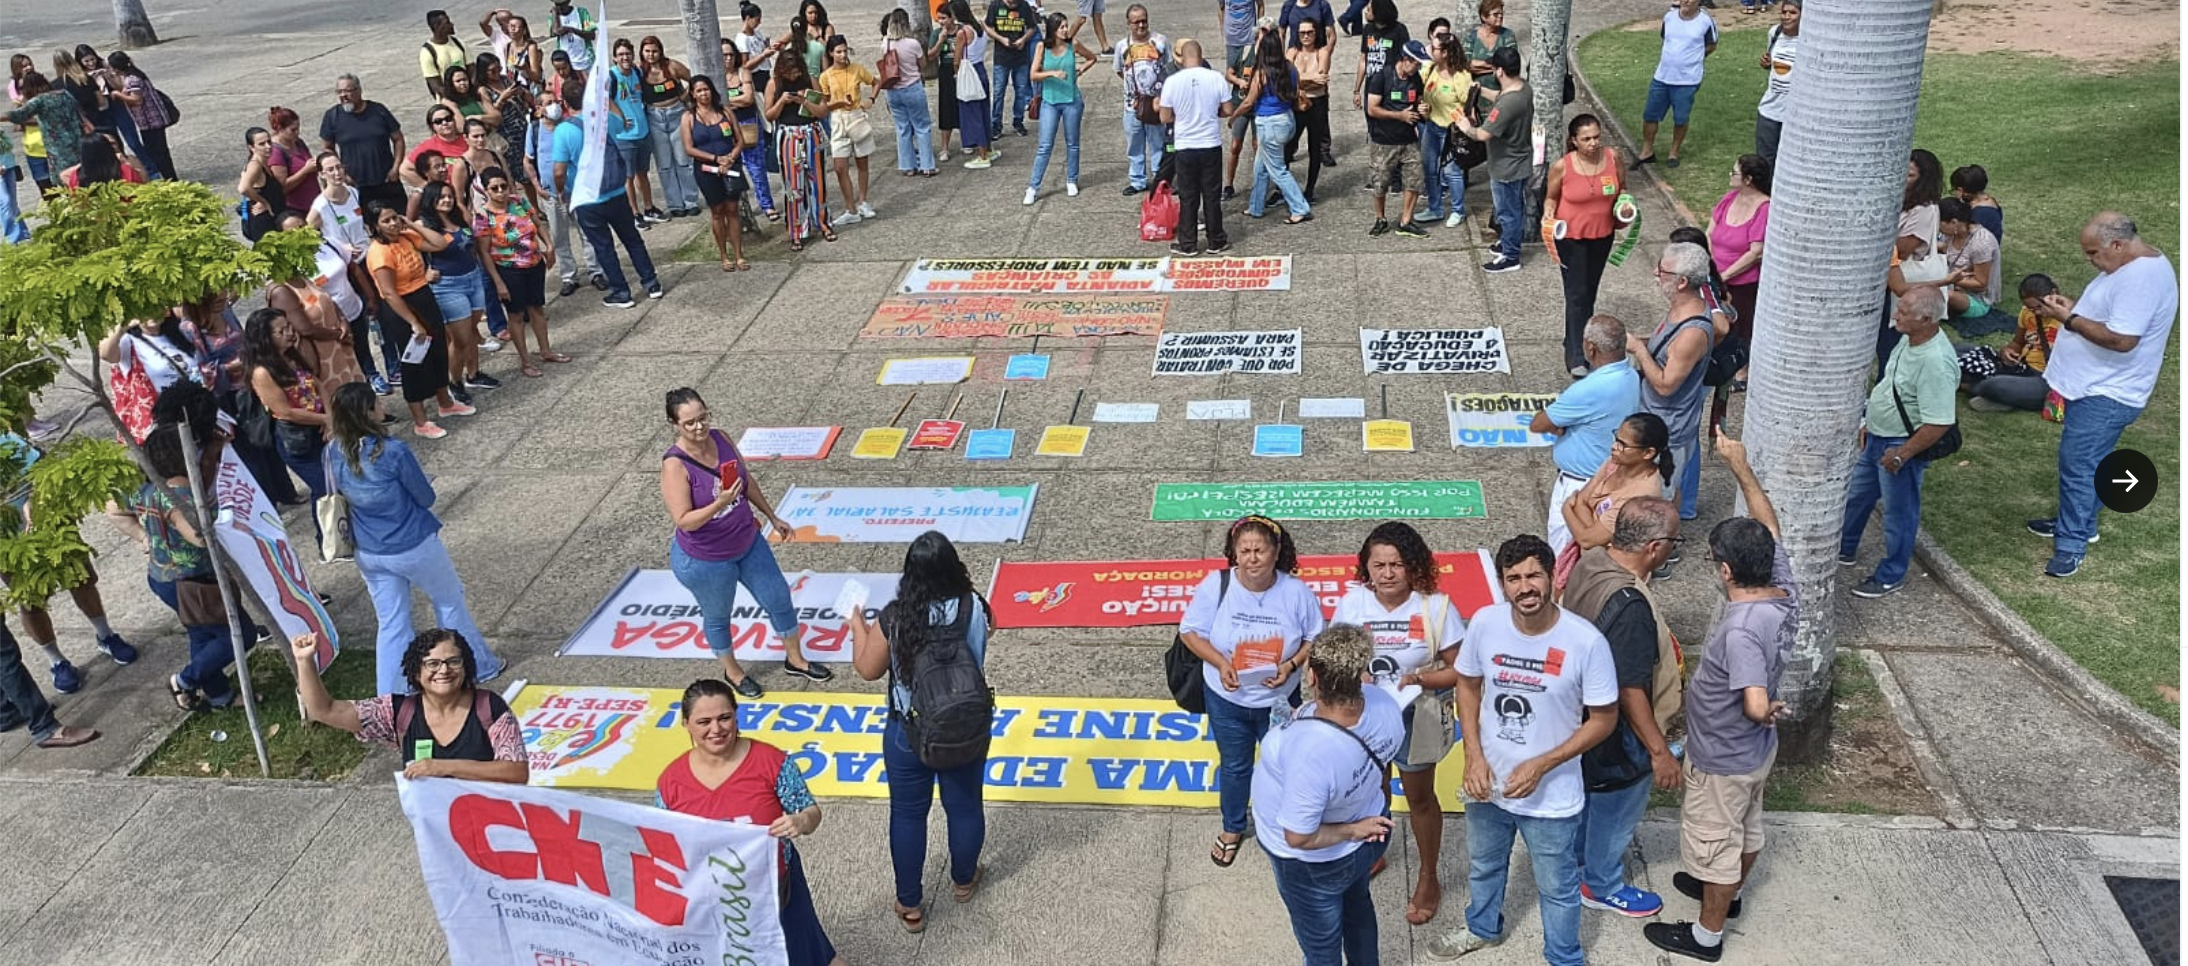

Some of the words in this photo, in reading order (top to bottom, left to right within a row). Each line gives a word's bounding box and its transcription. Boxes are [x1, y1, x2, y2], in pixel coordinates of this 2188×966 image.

[934, 260, 1048, 271] PROFESSORES
[1053, 261, 1089, 270] TEM
[1137, 261, 1159, 270] SE
[1180, 260, 1245, 269] MASSA
[1252, 260, 1282, 269] EM
[1088, 271, 1113, 280] AS
[925, 281, 1056, 291] MATRICULAR
[1066, 281, 1153, 291] ADIANTA
[1172, 280, 1269, 289] QUEREMOS
[1181, 335, 1249, 346] ASSUMIR
[1255, 334, 1295, 345] PARA
[1157, 348, 1214, 360] PRONTOS
[1214, 346, 1275, 358] ESTAMOS
[1281, 346, 1297, 357] SE
[1369, 350, 1501, 361] PRIVATIZAR
[1240, 360, 1265, 371] QUE
[1268, 360, 1295, 371] POR
[1376, 362, 1407, 371] DE
[1417, 361, 1497, 371] CHEGA
[1458, 429, 1528, 447] NÃO
[1433, 488, 1471, 497] POR
[1239, 500, 1314, 508] EDUCAM
[828, 505, 914, 518] SALARIAL
[920, 505, 1019, 518] REAJUSTE
[1092, 569, 1204, 582] MORDAÇA
[537, 694, 649, 712] SEPE-RJ
[524, 711, 598, 729] 1977
[531, 761, 552, 771] NA
[448, 793, 690, 927] CNTE
[666, 941, 700, 955] dos
